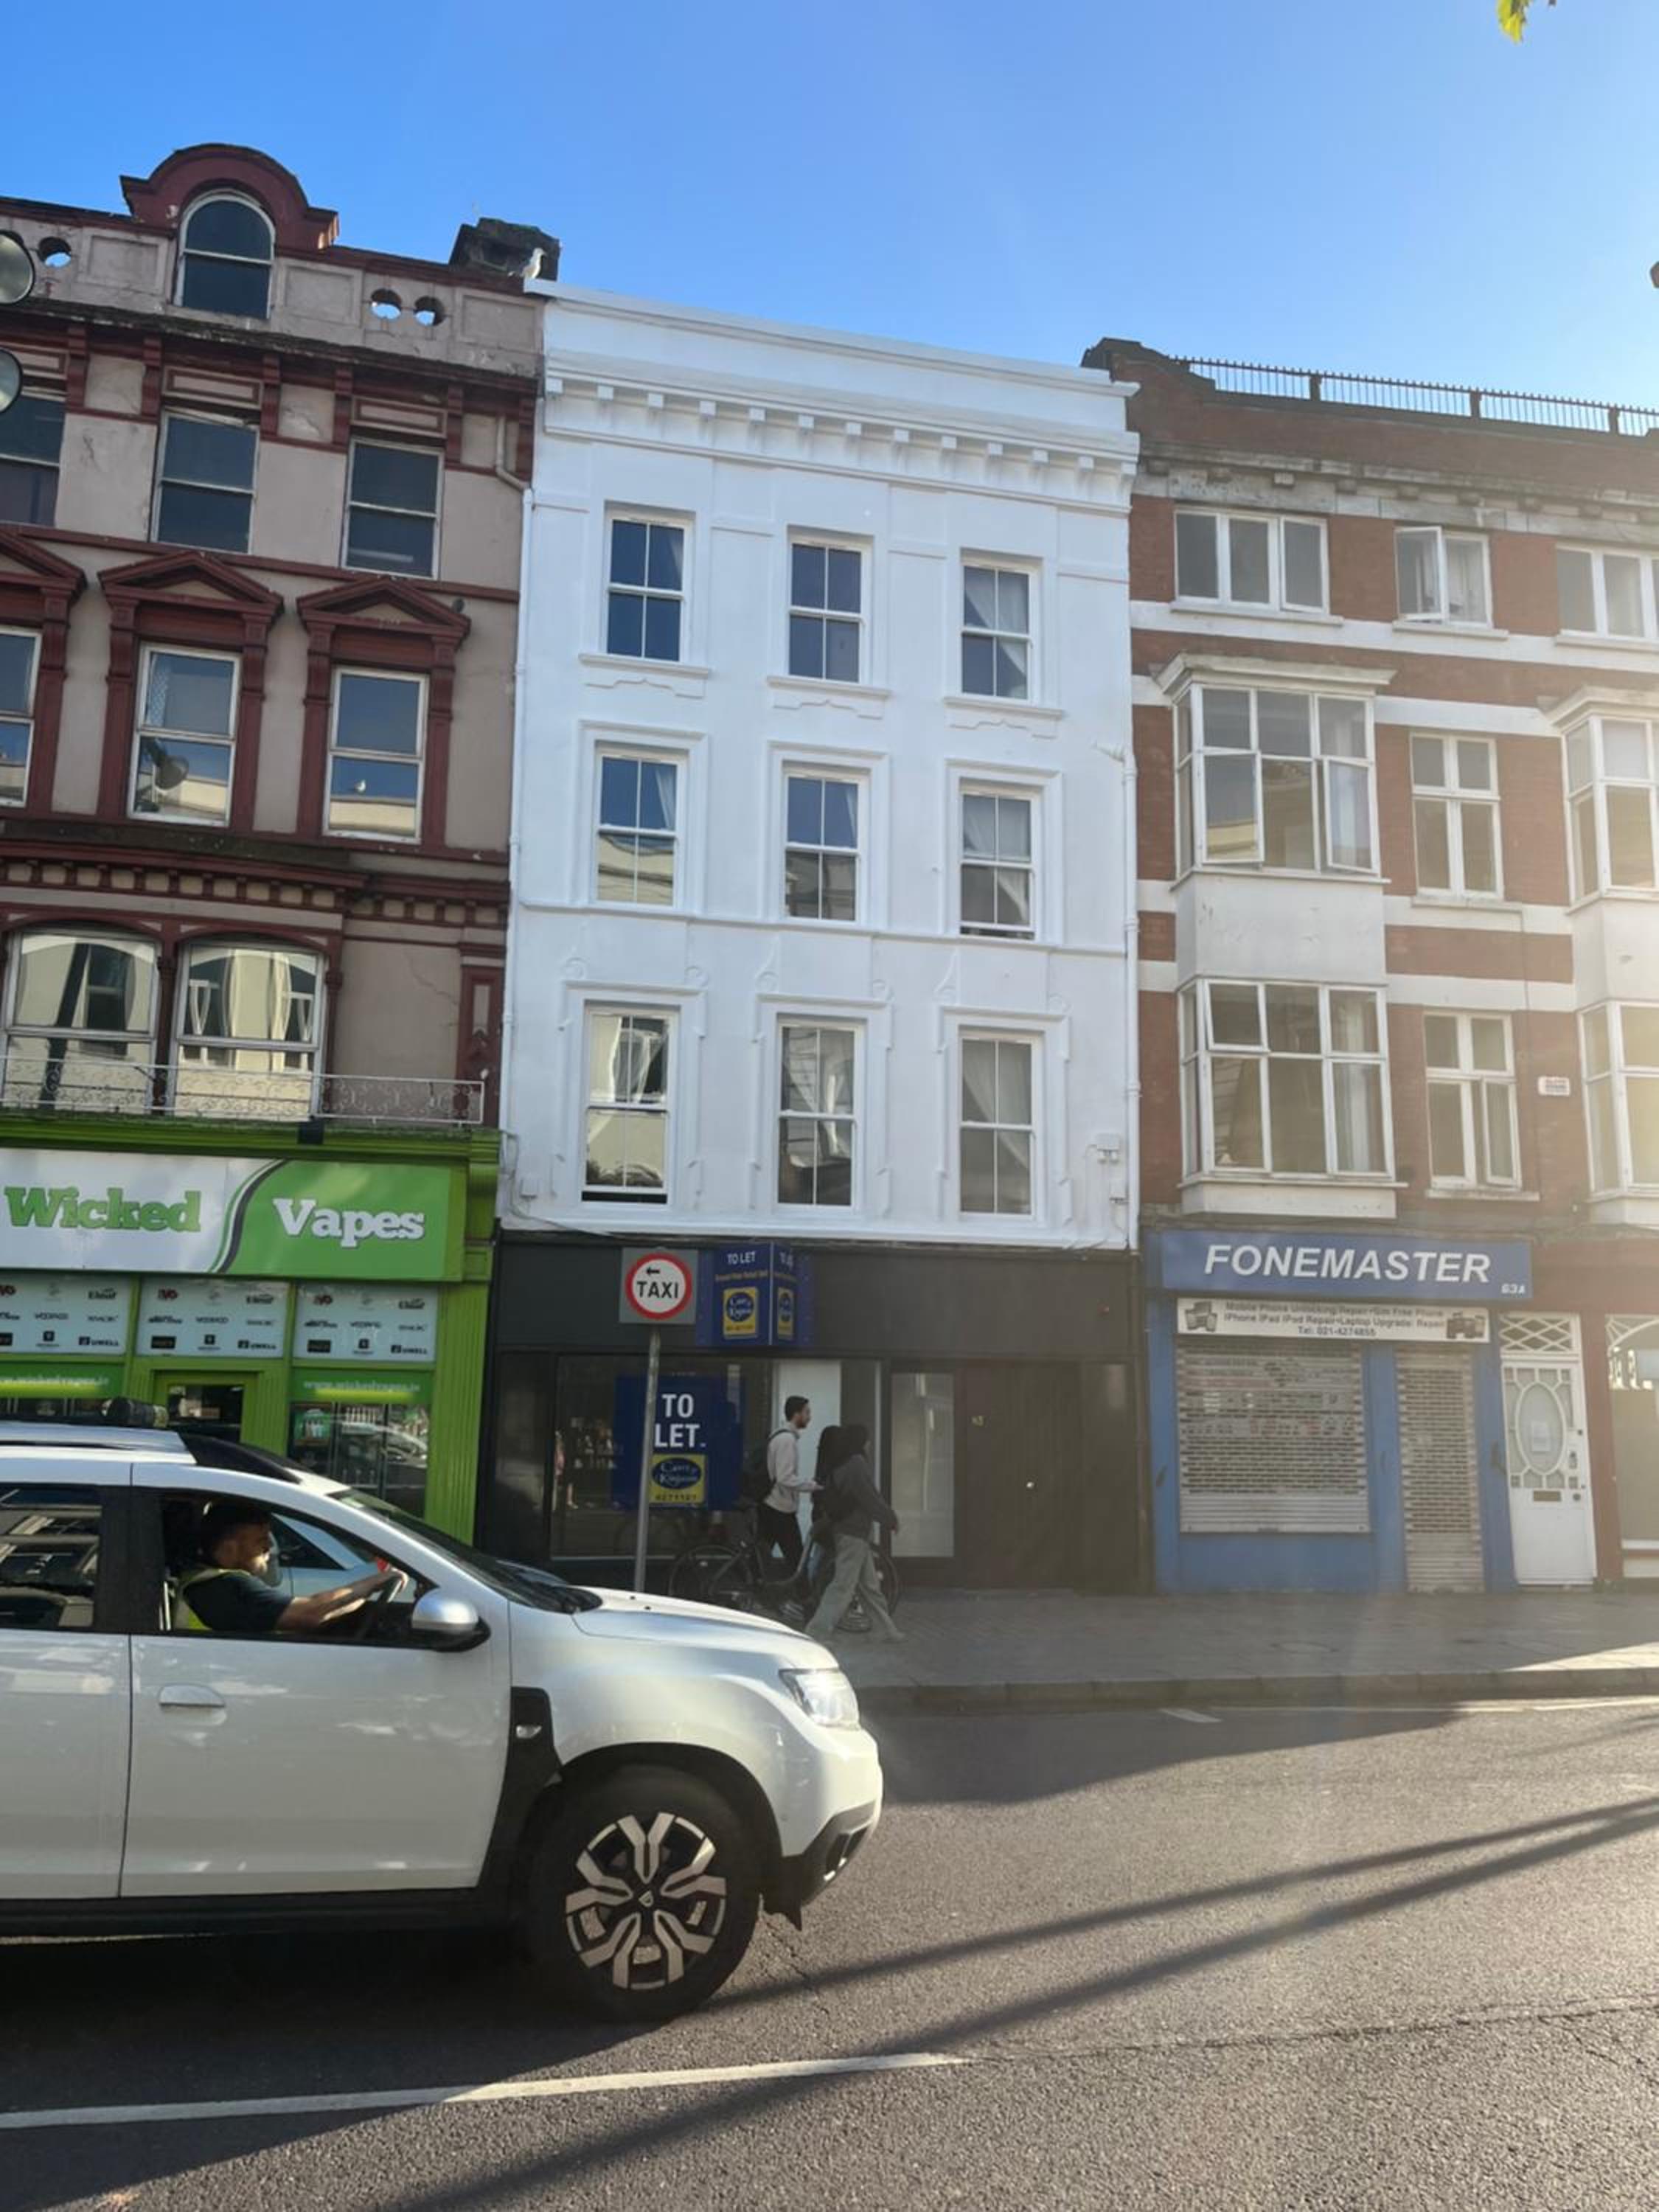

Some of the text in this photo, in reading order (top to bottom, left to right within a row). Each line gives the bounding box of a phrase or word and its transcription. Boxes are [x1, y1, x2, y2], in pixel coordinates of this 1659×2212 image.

[3, 1186, 425, 1248] Wicked Vapes
[727, 1251, 756, 1265] TO LET
[1203, 1244, 1492, 1283] FONEMASTER
[636, 1281, 679, 1298] TAXI
[661, 1393, 695, 1418] TO
